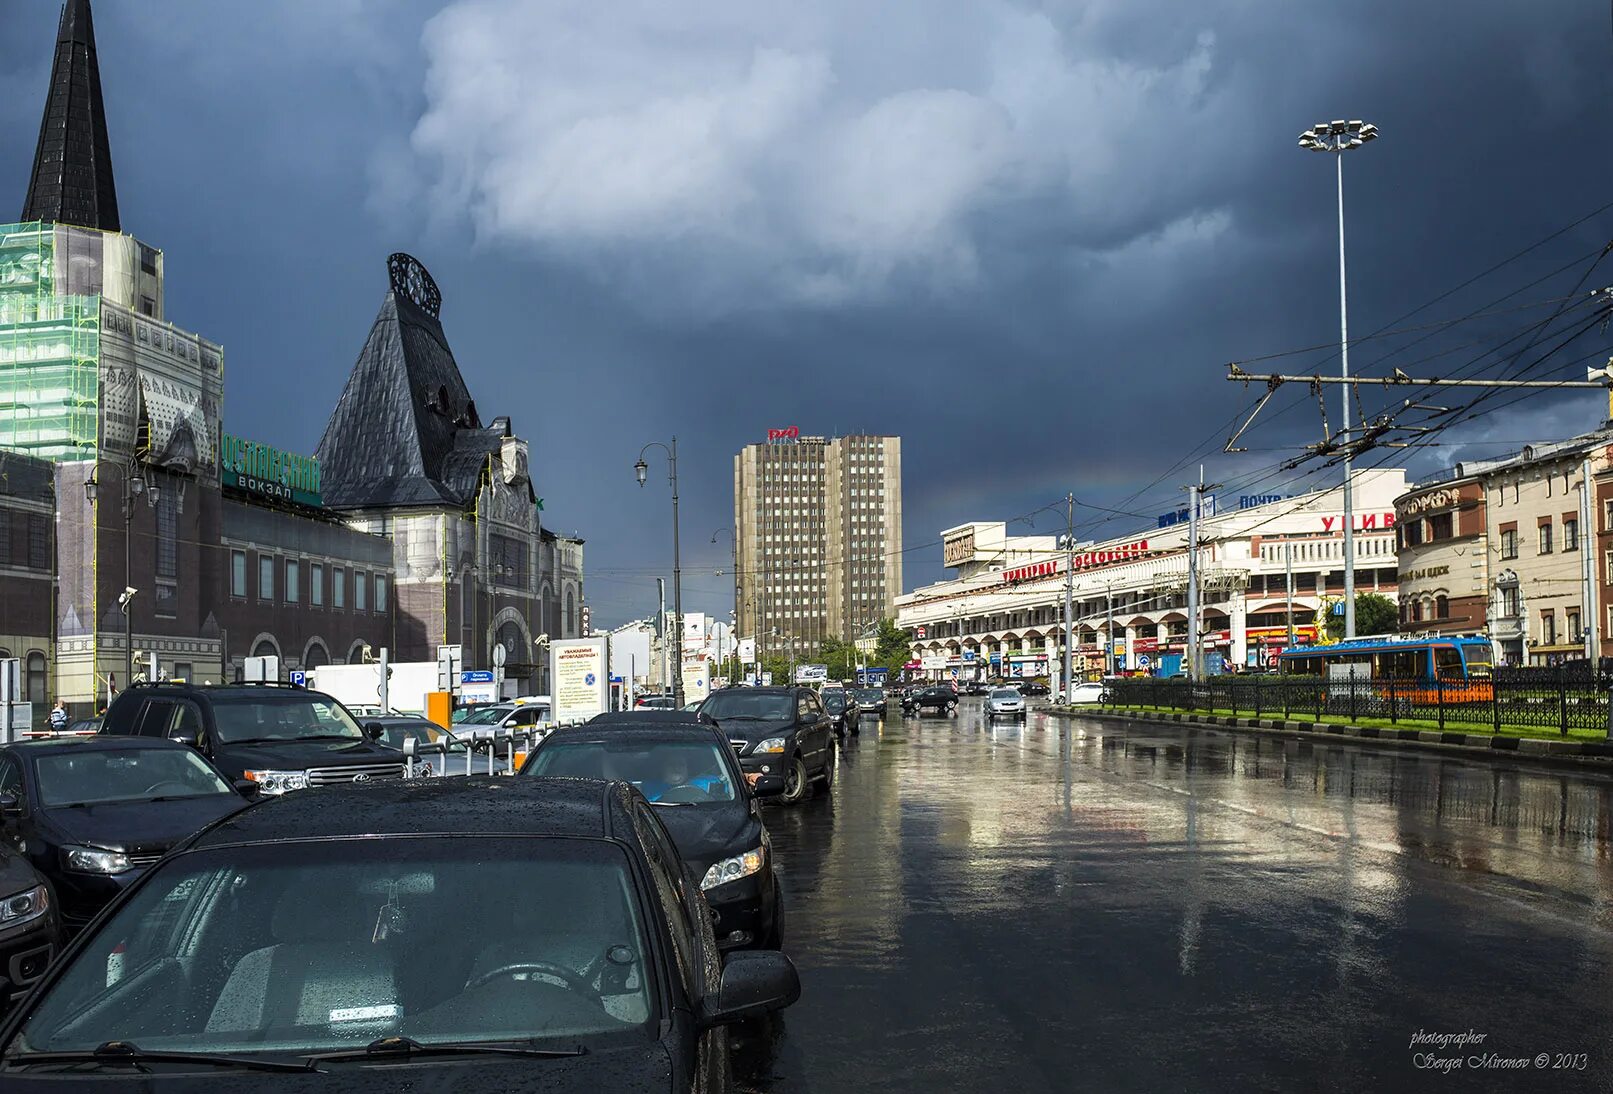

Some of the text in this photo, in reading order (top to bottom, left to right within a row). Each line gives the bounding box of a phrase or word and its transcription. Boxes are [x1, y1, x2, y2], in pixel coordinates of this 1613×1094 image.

[238, 476, 291, 499] ВОКЗАЛ
[1002, 540, 1148, 581] УНИВЕРМАГ ОСКОВСКИЙ
